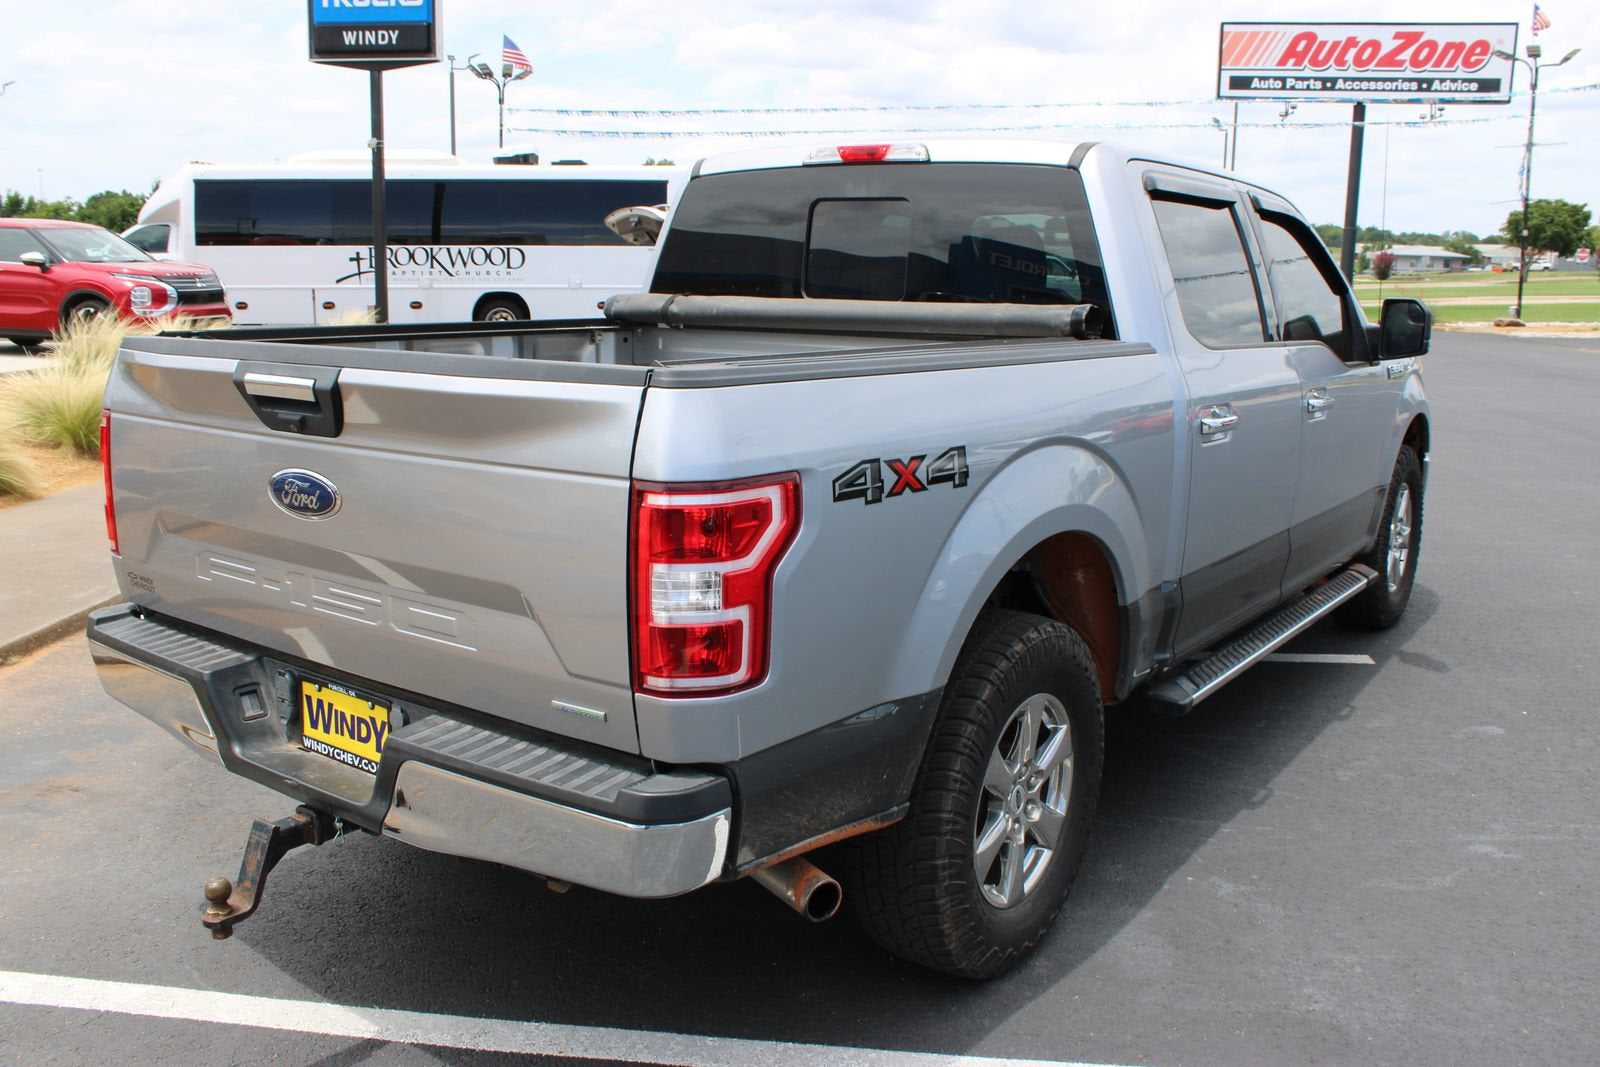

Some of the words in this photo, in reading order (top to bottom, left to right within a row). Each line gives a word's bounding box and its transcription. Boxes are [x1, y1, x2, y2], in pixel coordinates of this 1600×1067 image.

[342, 30, 400, 45] WINDY
[1276, 31, 1492, 71] AutoZone
[1250, 77, 1283, 89] Auto
[1285, 78, 1323, 90] Parts
[1334, 78, 1418, 91] Accessories
[1431, 80, 1479, 92] Advice
[281, 478, 320, 510] Ford
[195, 550, 478, 652] F-150
[304, 693, 388, 754] WINDY
[302, 736, 380, 774] WINDYCHEV.CO
